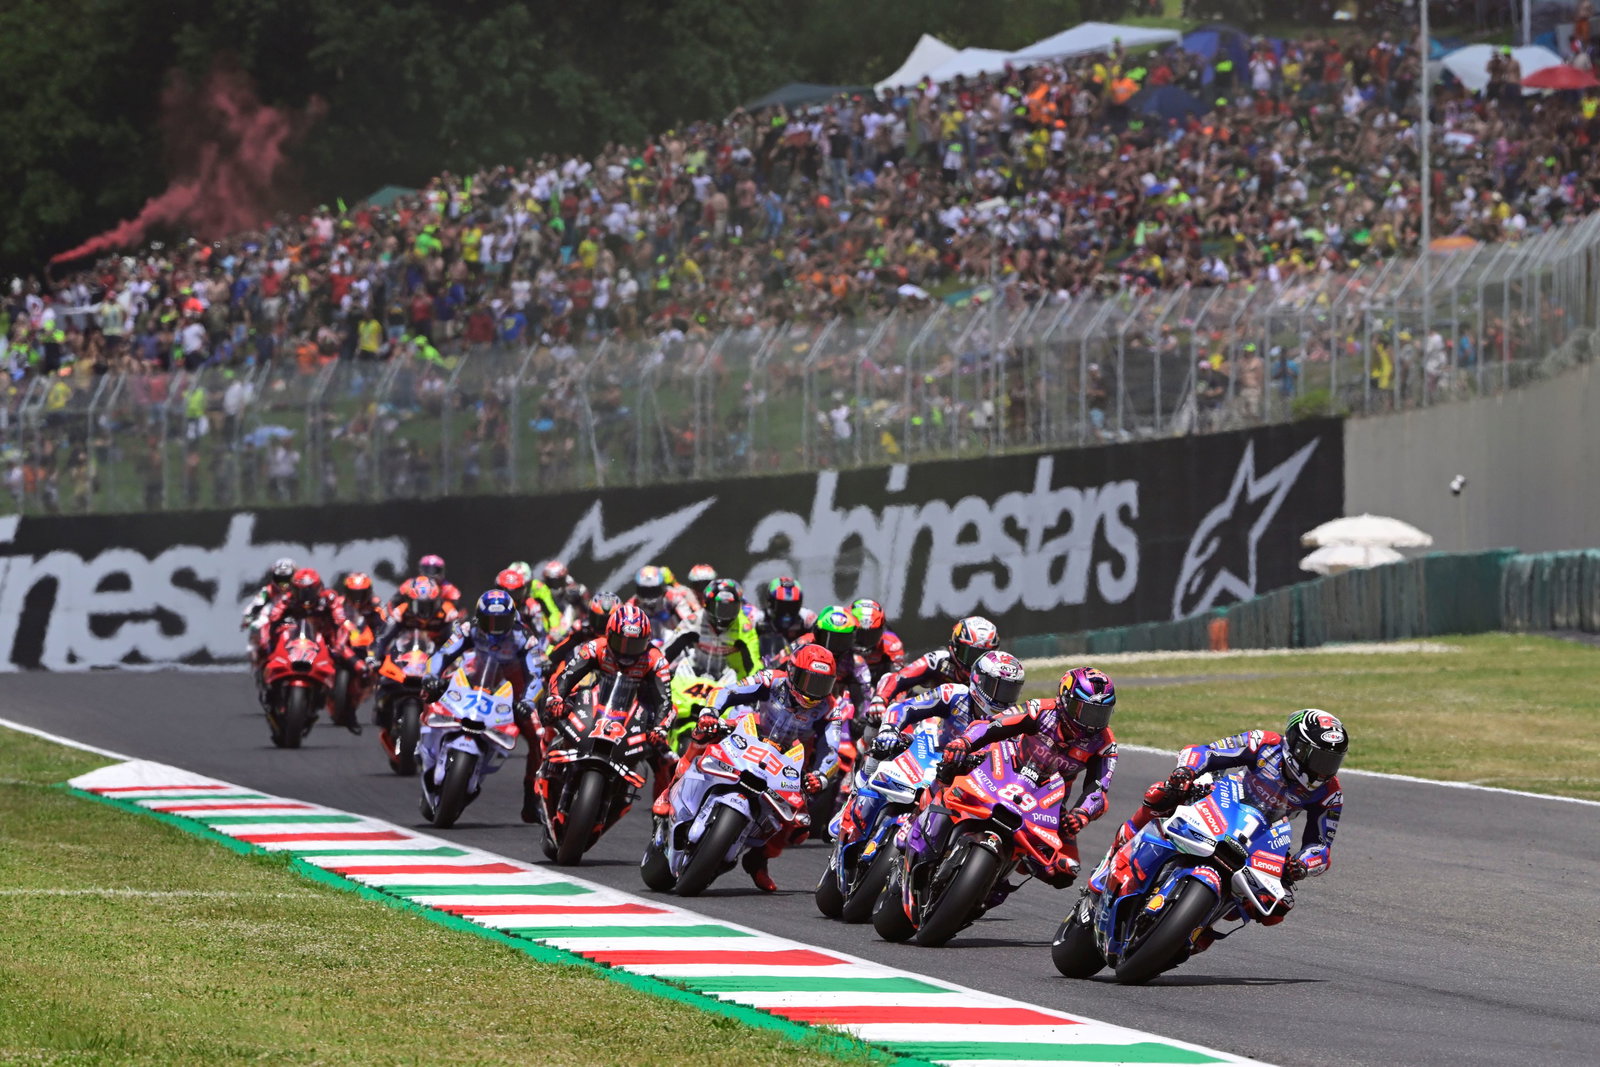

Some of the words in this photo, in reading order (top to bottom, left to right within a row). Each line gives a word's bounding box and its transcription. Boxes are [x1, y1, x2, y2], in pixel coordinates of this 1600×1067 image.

[741, 745, 784, 776] 93
[998, 783, 1038, 812] 89
[1032, 812, 1058, 825] prima
[1197, 801, 1221, 833] Lenovo
[1032, 826, 1061, 847] MOTUL
[1253, 858, 1281, 873] Lenovo
